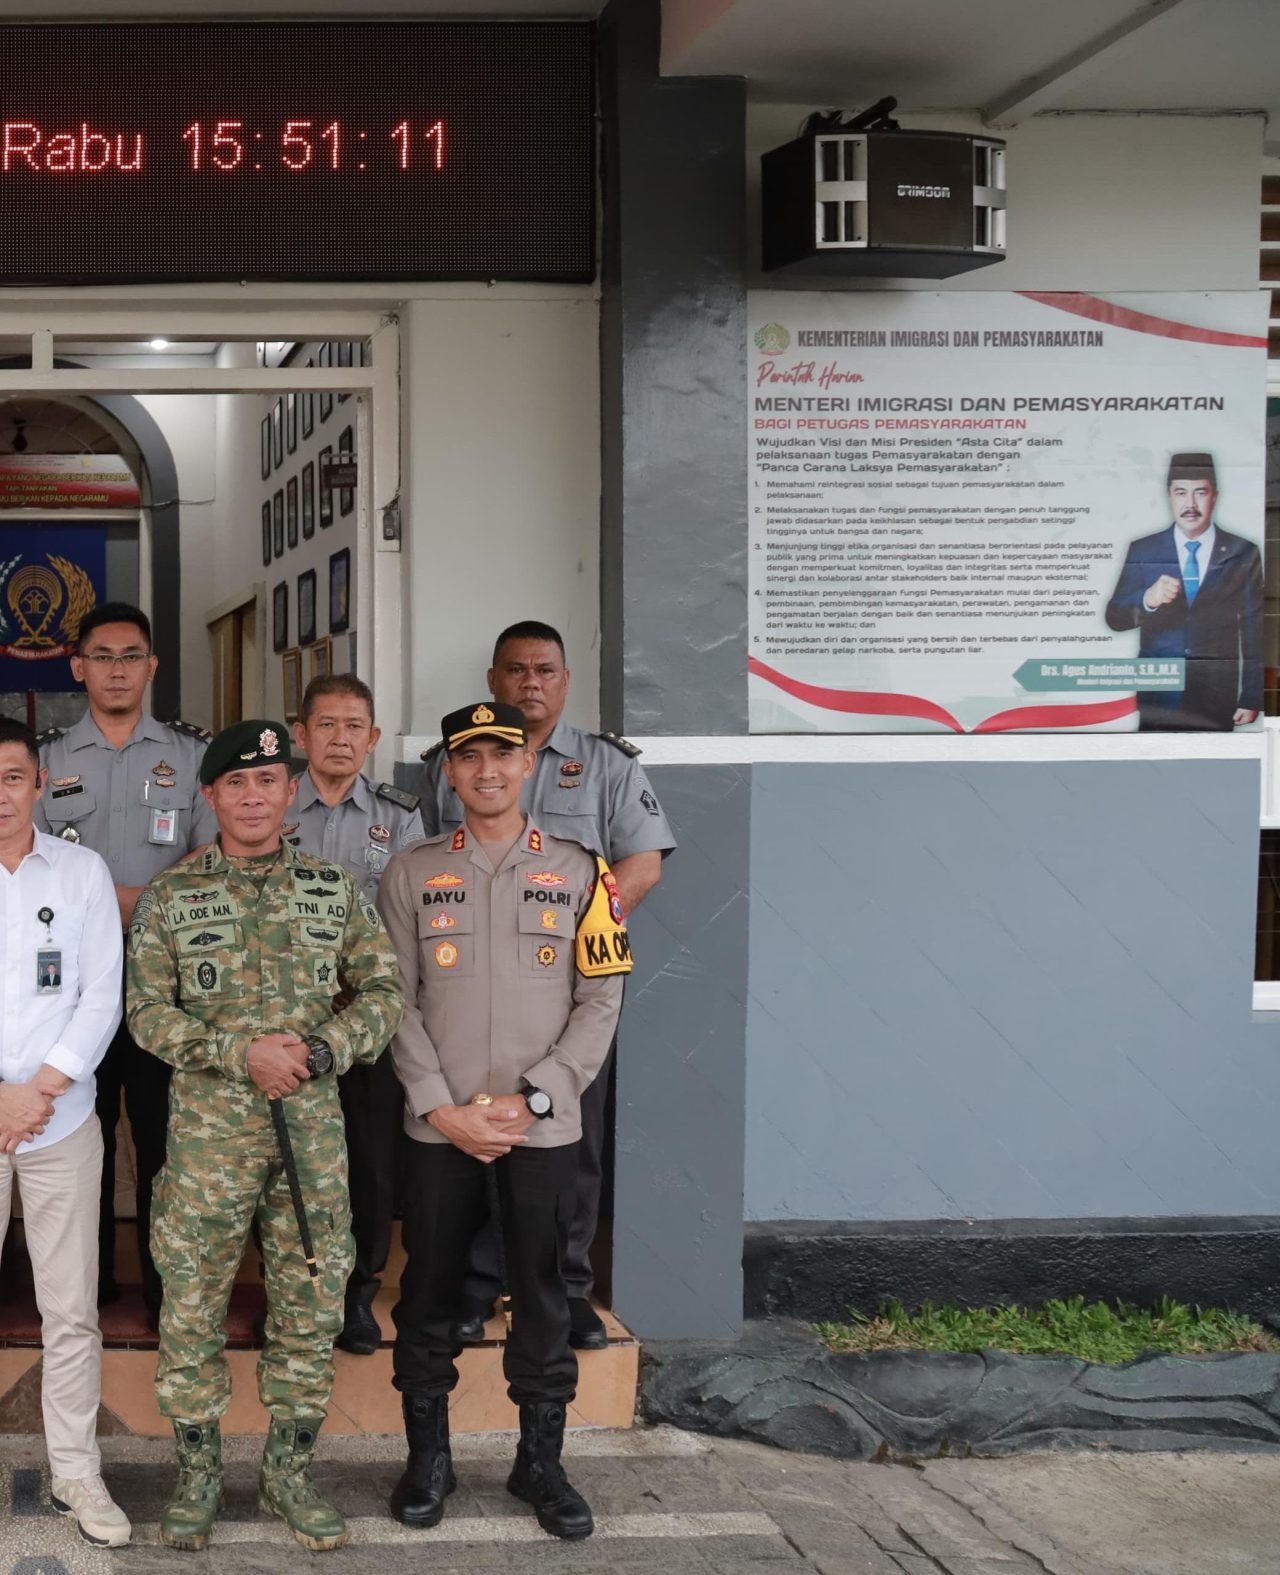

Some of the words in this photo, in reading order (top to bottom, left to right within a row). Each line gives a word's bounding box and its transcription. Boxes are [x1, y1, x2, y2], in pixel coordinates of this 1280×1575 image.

[2, 121, 143, 171] Rabu
[798, 330, 886, 347] KEMENTERIAN
[890, 330, 949, 347] IMIGRASI
[953, 330, 979, 347] DAN
[983, 330, 1103, 347] PEMASYARAKATAN
[757, 361, 815, 387] Perintah
[818, 361, 864, 389] Harian
[755, 397, 850, 412] MENTERI
[857, 397, 952, 412] IMIGRASI
[960, 397, 1006, 412] DAN
[1013, 397, 1224, 412] PEMASYARAKATAN
[754, 418, 791, 430] BAGI
[797, 418, 870, 430] PETUGAS
[875, 418, 1026, 430] PEMASYARAKATAN
[756, 438, 815, 448] Wujudkan
[819, 438, 841, 446] Visi
[845, 438, 867, 446] dan
[871, 438, 895, 446] Misi
[899, 438, 952, 446] Presiden
[956, 438, 989, 446] "Asta
[992, 438, 1023, 446] Cita"
[1026, 438, 1063, 446] dalam
[755, 451, 831, 461] pelaksanaan
[834, 451, 868, 461] tugas
[871, 451, 973, 461] Pemasyarakatan
[976, 451, 1020, 461] dengan
[802, 464, 846, 472] Carana
[850, 464, 893, 474] Laksya
[422, 890, 465, 906] BAYU
[523, 890, 571, 906] POLRI
[173, 911, 186, 925] LA
[190, 908, 210, 920] ODE
[213, 904, 233, 917] M.N.
[295, 902, 319, 915] TNI
[327, 905, 345, 918] AD
[584, 933, 612, 966] KA
